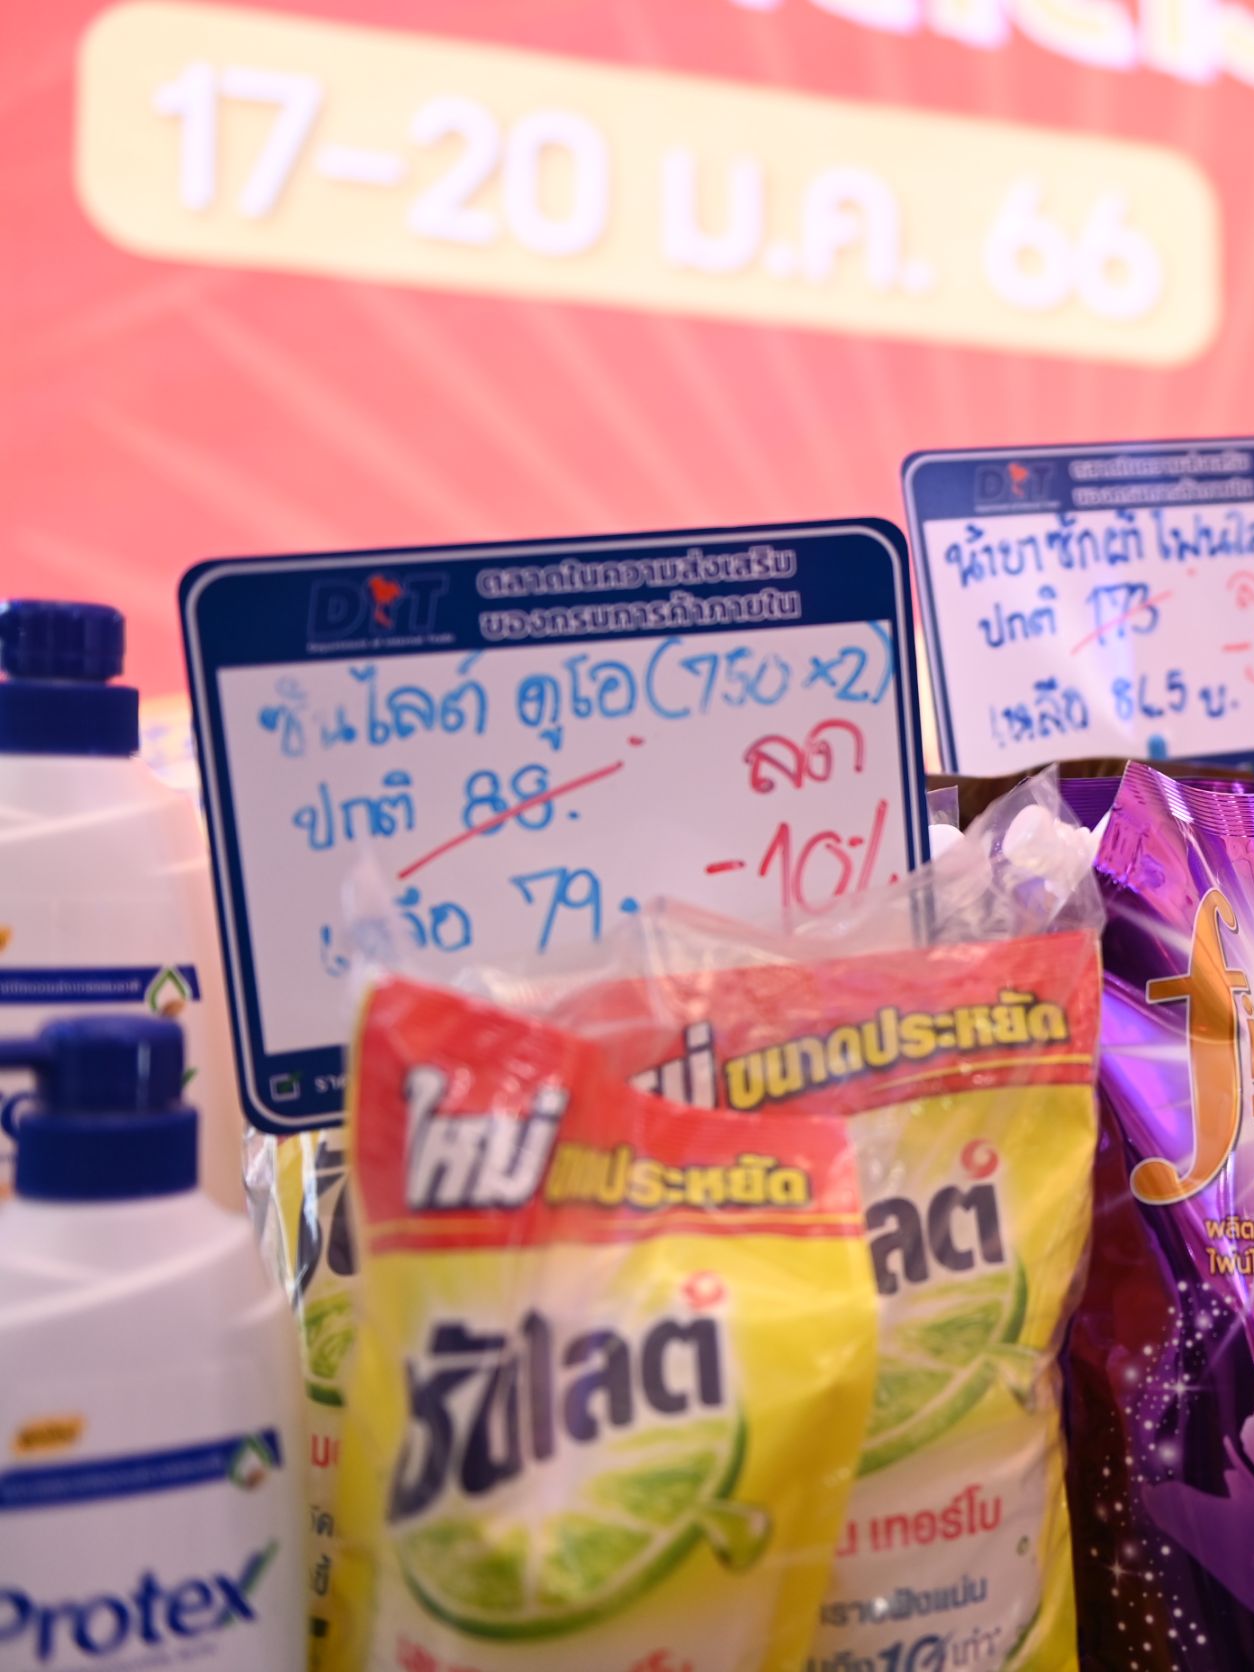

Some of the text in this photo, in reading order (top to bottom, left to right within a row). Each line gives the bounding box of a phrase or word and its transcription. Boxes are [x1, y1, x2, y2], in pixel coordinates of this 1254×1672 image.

[150, 60, 612, 256] 17-20
[982, 174, 1163, 318] 66
[743, 718, 865, 795] ลด
[293, 769, 416, 852] ปกติ
[725, 988, 1070, 1113] ขนาดประหยัด
[868, 1483, 1004, 1553] เทอร์โบ
